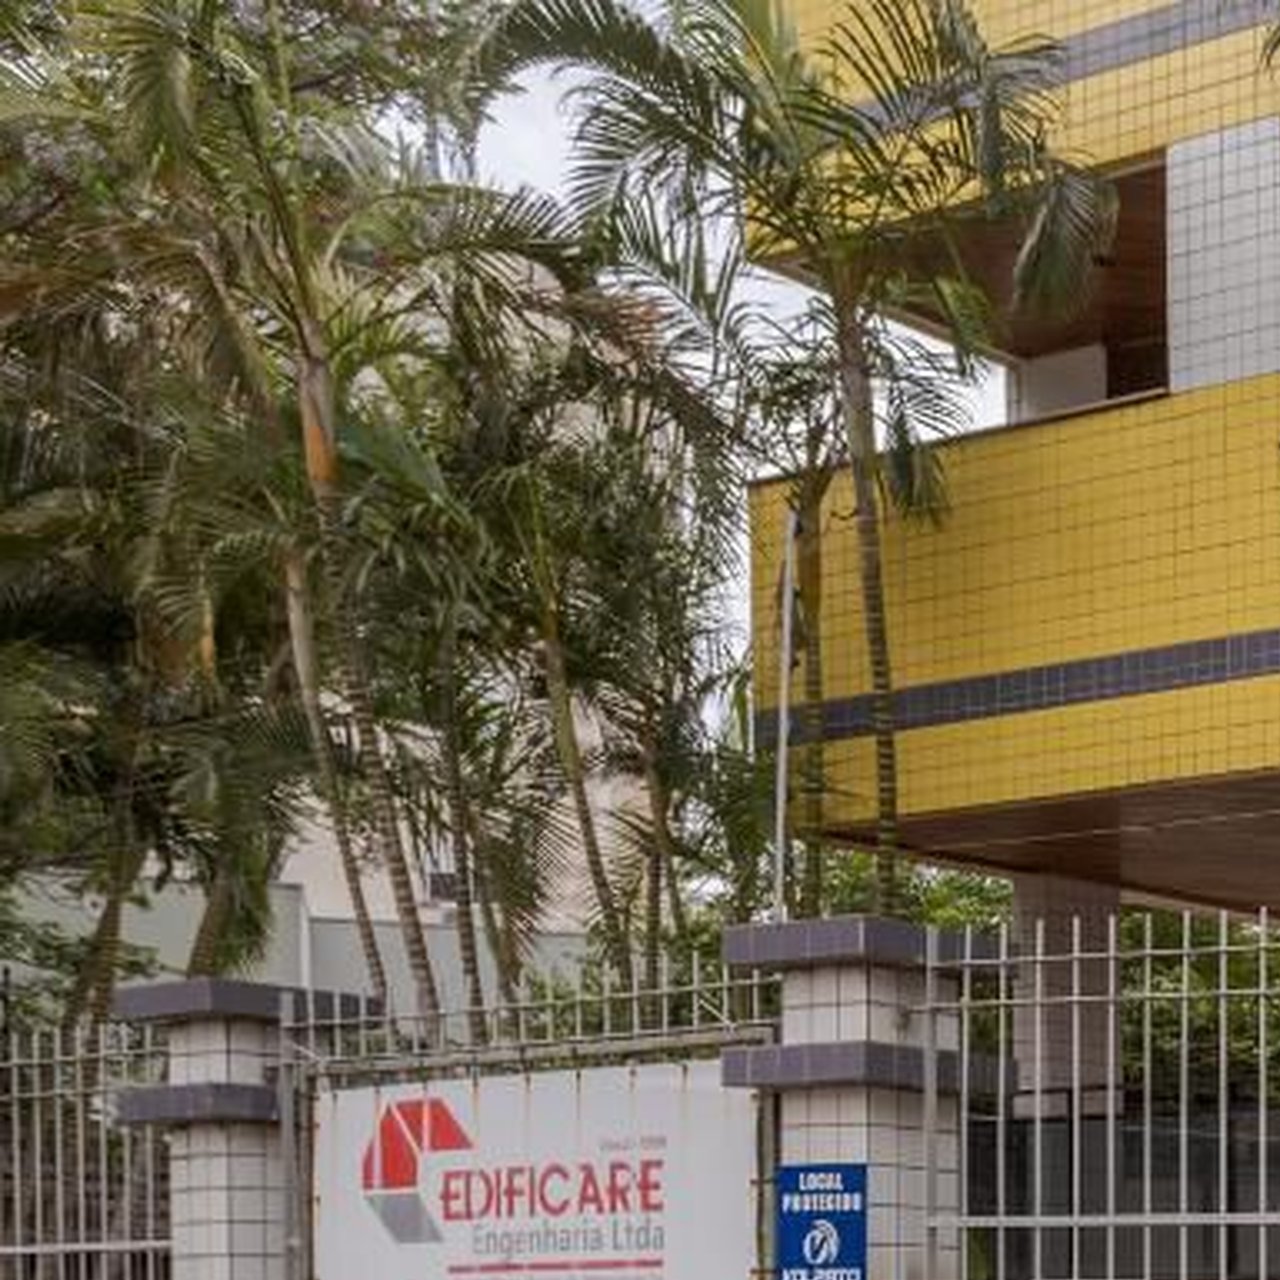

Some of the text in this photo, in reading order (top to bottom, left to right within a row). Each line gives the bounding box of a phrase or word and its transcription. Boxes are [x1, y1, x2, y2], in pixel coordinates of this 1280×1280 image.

[440, 1160, 664, 1221] EDIFICARE
[798, 1172, 844, 1191] LOCAL
[473, 1219, 665, 1258] Engenharia Ltda
